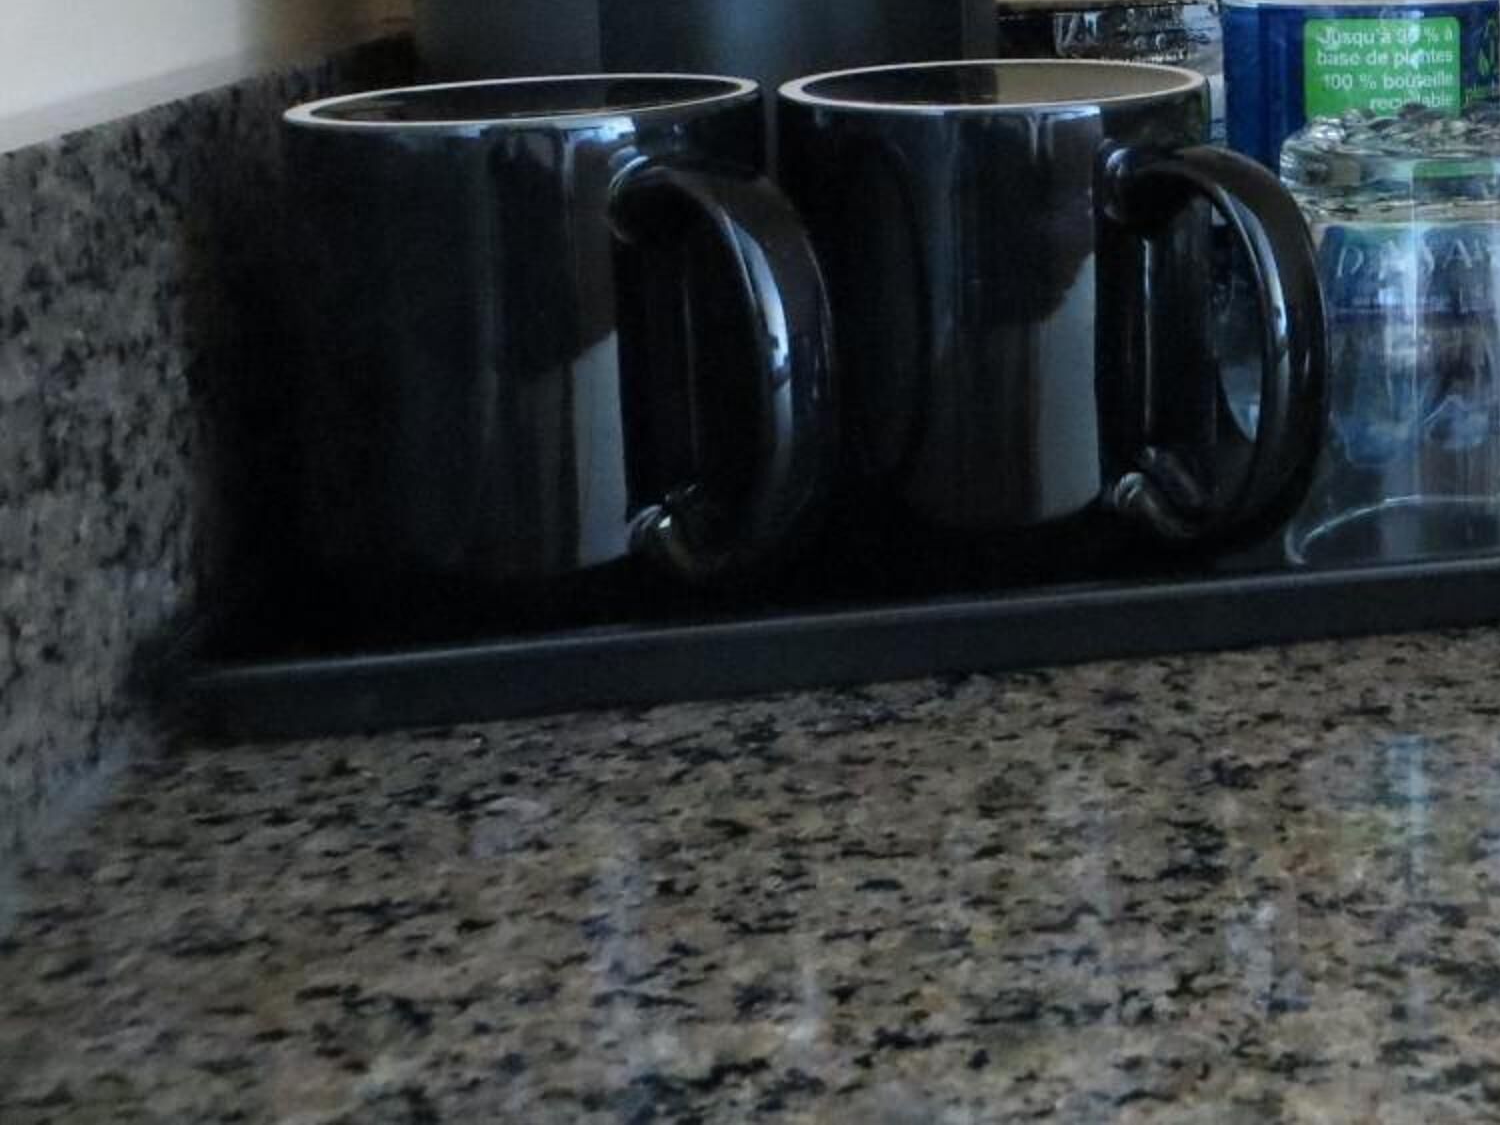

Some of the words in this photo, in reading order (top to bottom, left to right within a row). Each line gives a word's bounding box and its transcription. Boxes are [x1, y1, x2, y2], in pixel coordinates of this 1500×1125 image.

[1424, 27, 1440, 43] %
[1317, 50, 1361, 66] base
[1366, 49, 1389, 66] de
[1323, 74, 1353, 90] 100
[1360, 73, 1377, 89] %
